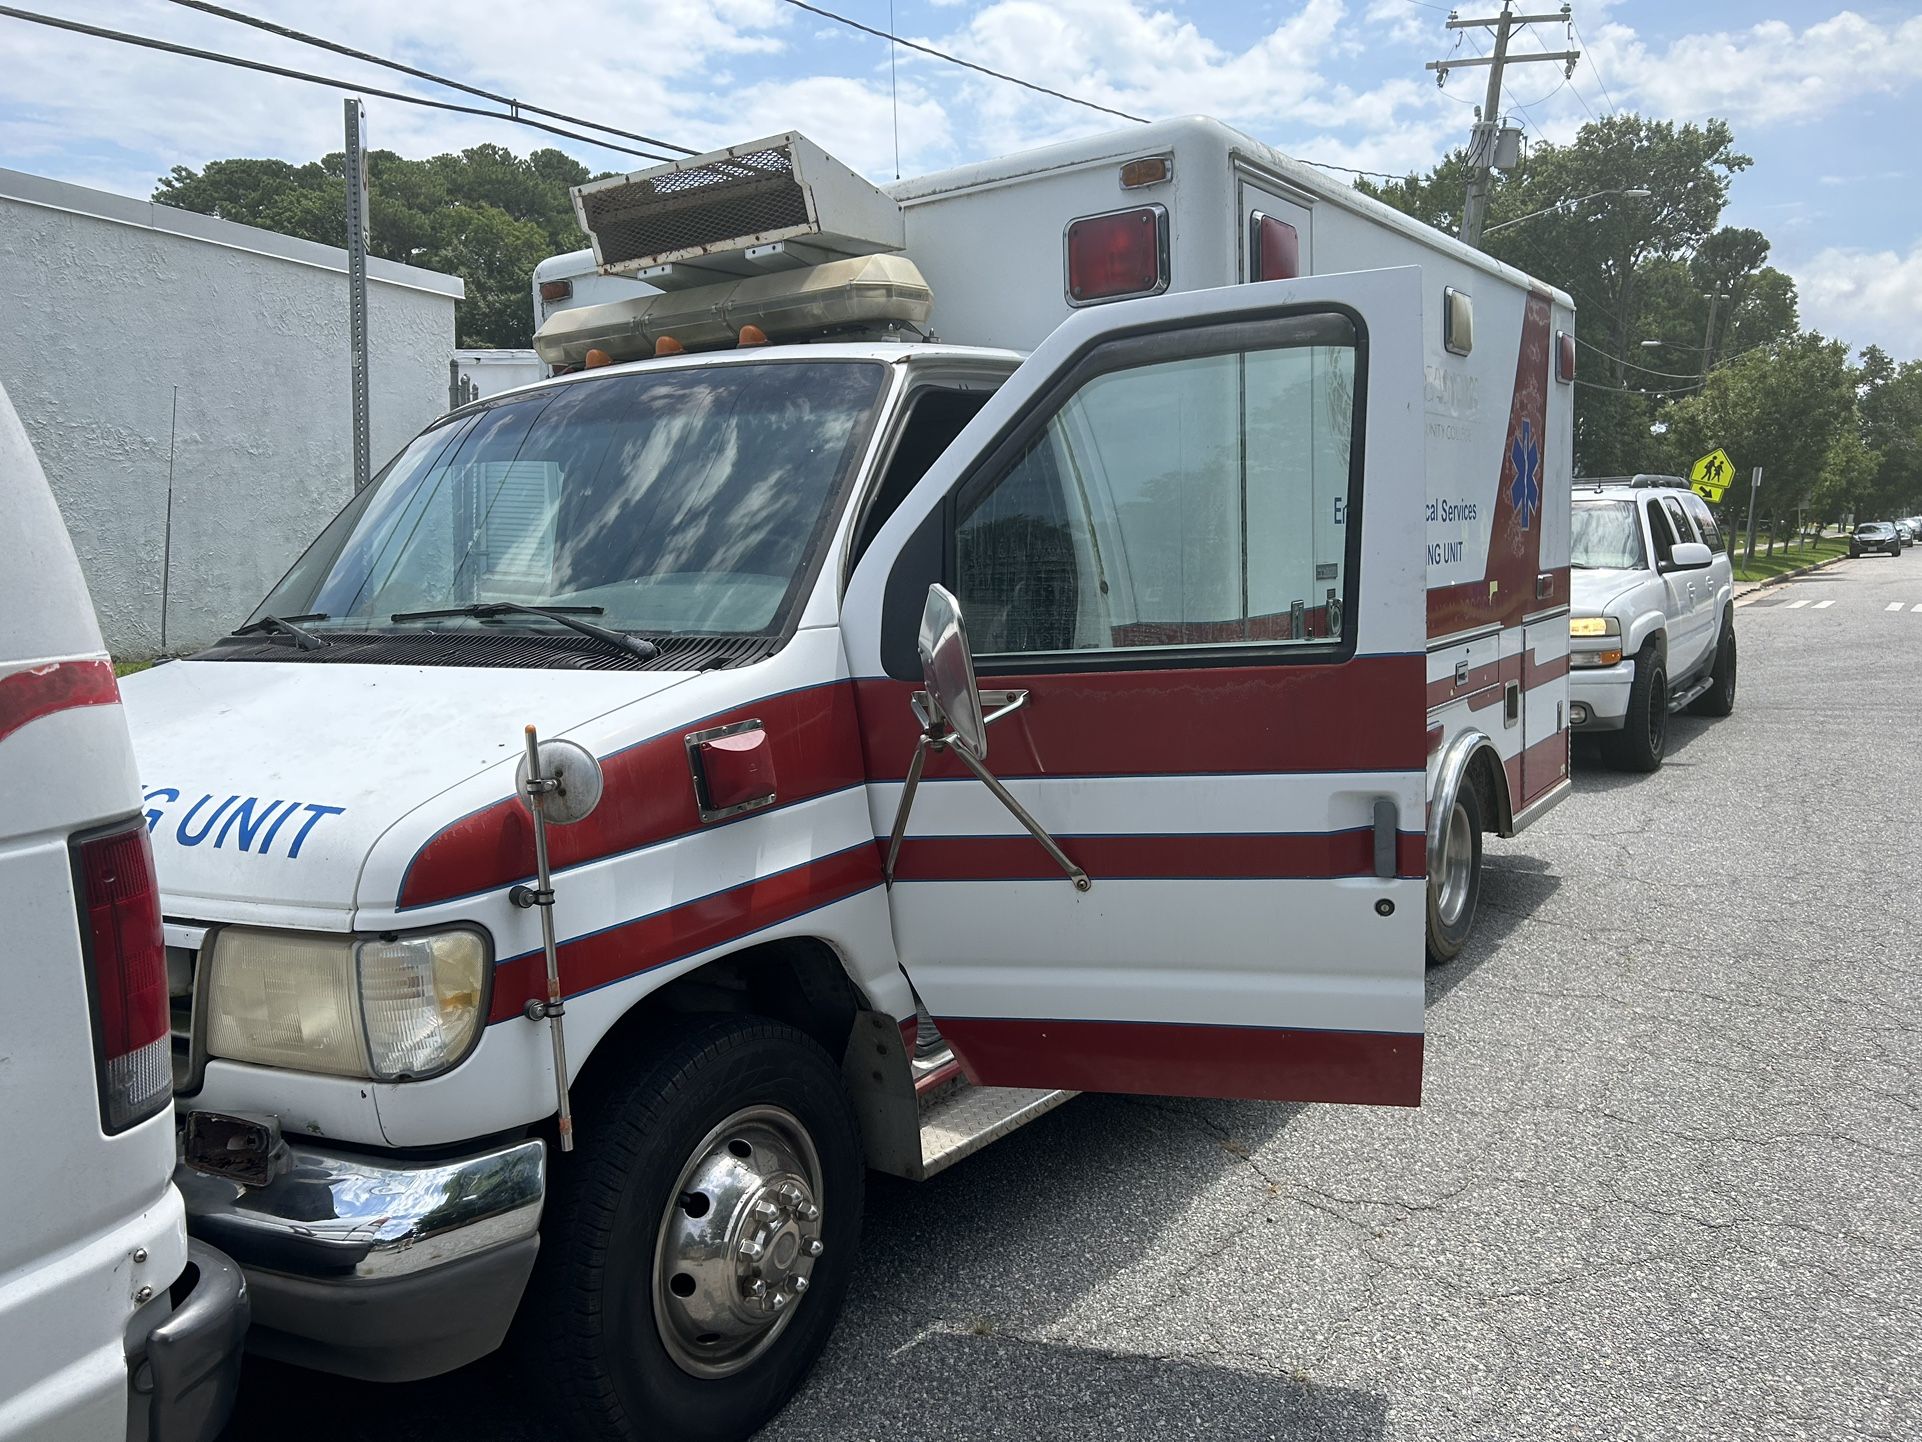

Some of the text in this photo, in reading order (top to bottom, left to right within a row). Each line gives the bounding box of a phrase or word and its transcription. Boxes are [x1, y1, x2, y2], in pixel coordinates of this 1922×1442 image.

[1441, 497, 1477, 523] Services
[1444, 541, 1464, 564] UNIT
[141, 785, 347, 859] G UNIT
